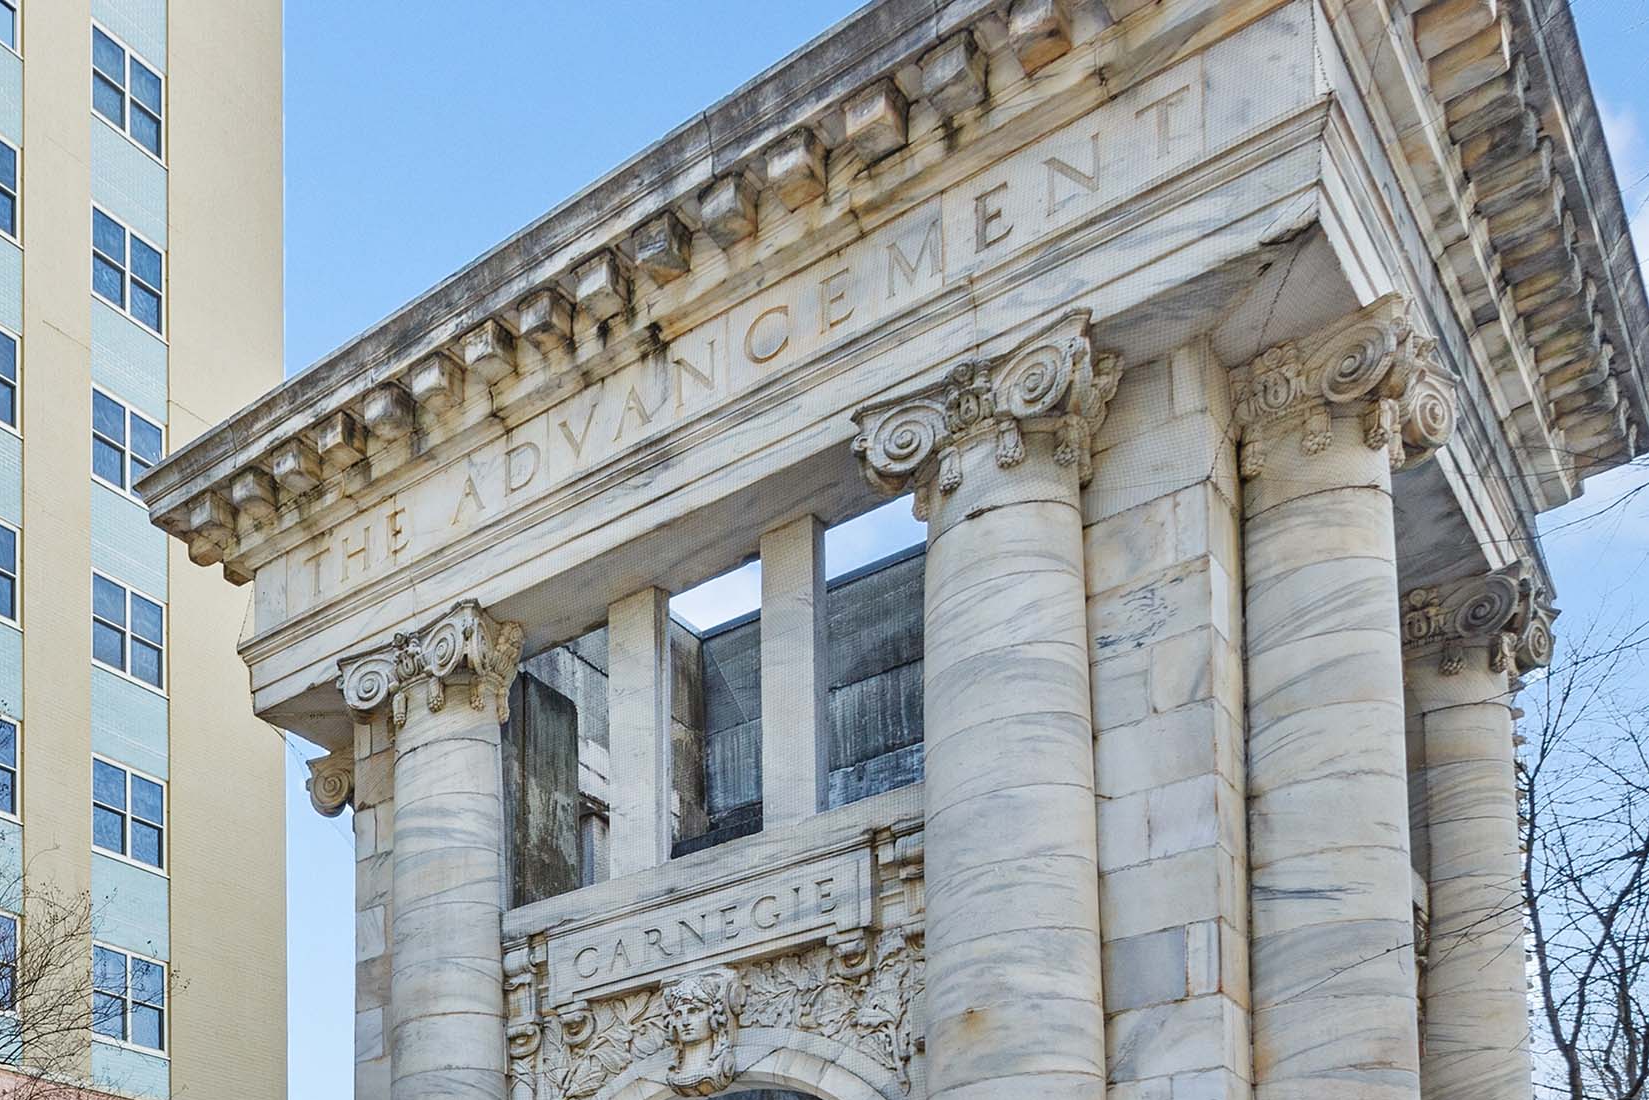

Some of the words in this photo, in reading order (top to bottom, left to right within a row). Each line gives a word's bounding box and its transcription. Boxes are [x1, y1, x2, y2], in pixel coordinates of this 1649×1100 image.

[303, 505, 411, 597] THE
[450, 82, 1197, 527] ADVANCEMENT
[572, 876, 839, 979] CARNEGIE
